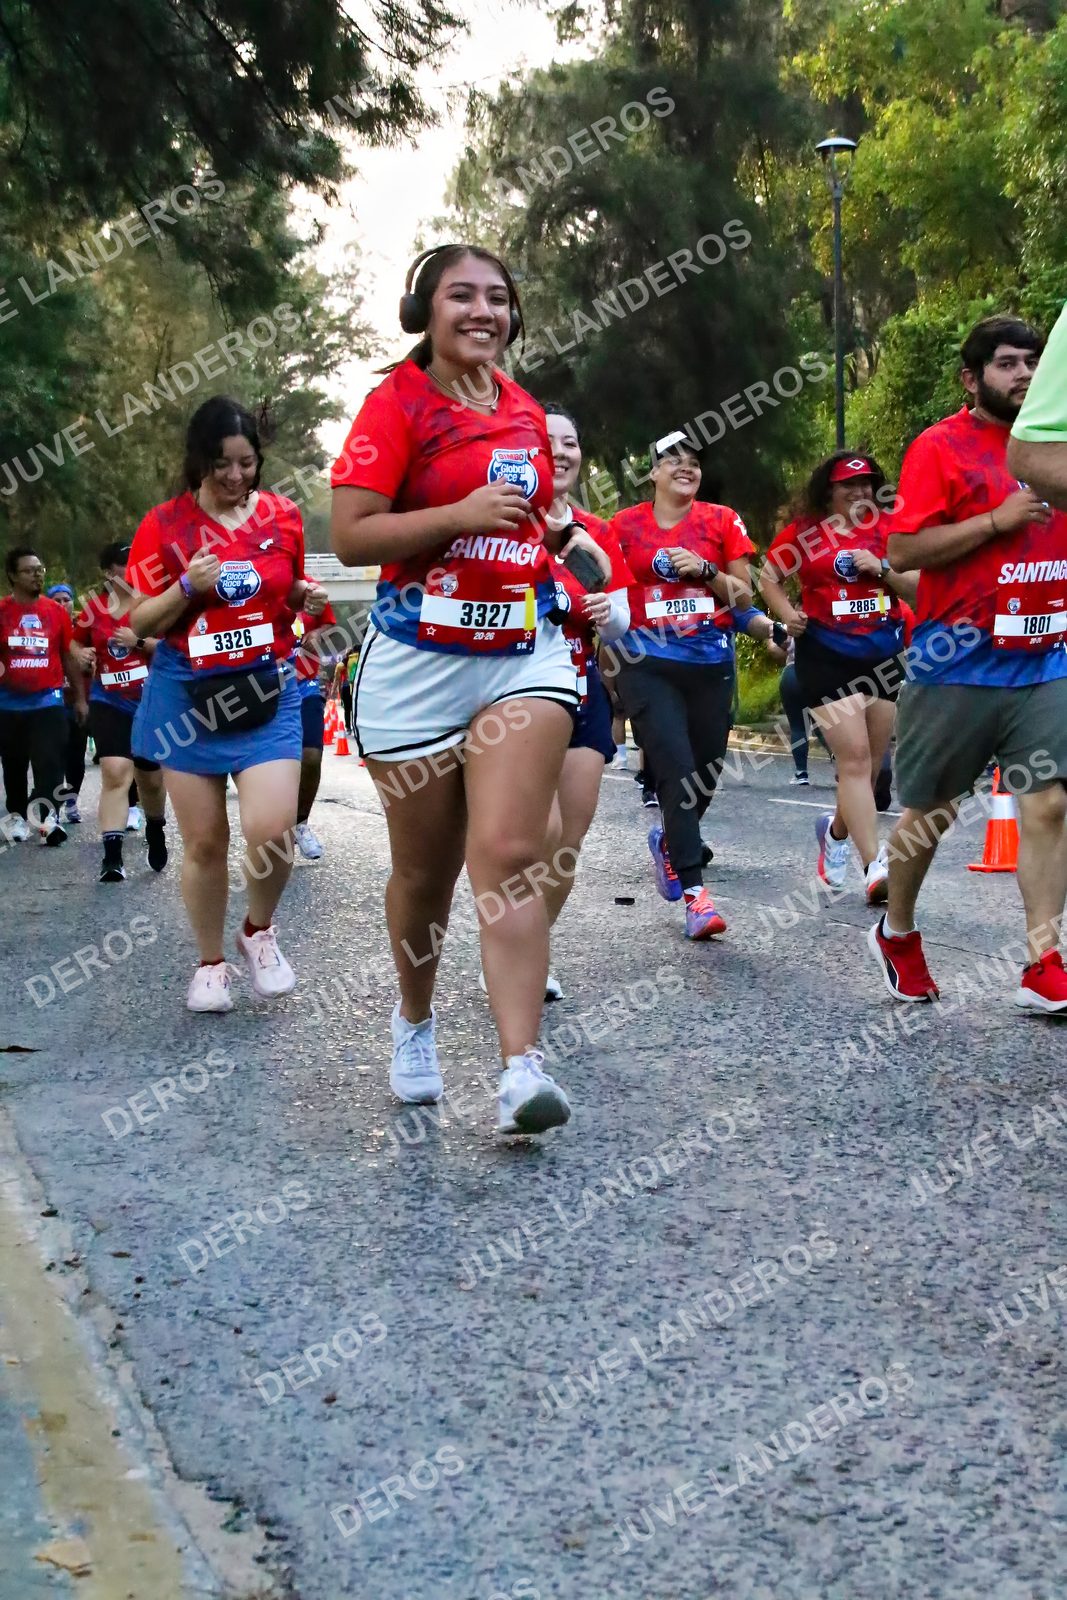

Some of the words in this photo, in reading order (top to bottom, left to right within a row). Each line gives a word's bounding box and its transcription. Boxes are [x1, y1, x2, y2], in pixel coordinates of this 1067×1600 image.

[500, 463, 526, 474] Global
[226, 572, 250, 582] Global
[849, 598, 877, 614] 2885
[460, 602, 512, 628] 3327
[1023, 615, 1052, 635] 1801
[213, 628, 253, 652] 3326
[10, 658, 49, 669] SANTIAGO
[113, 670, 131, 683] 1417
